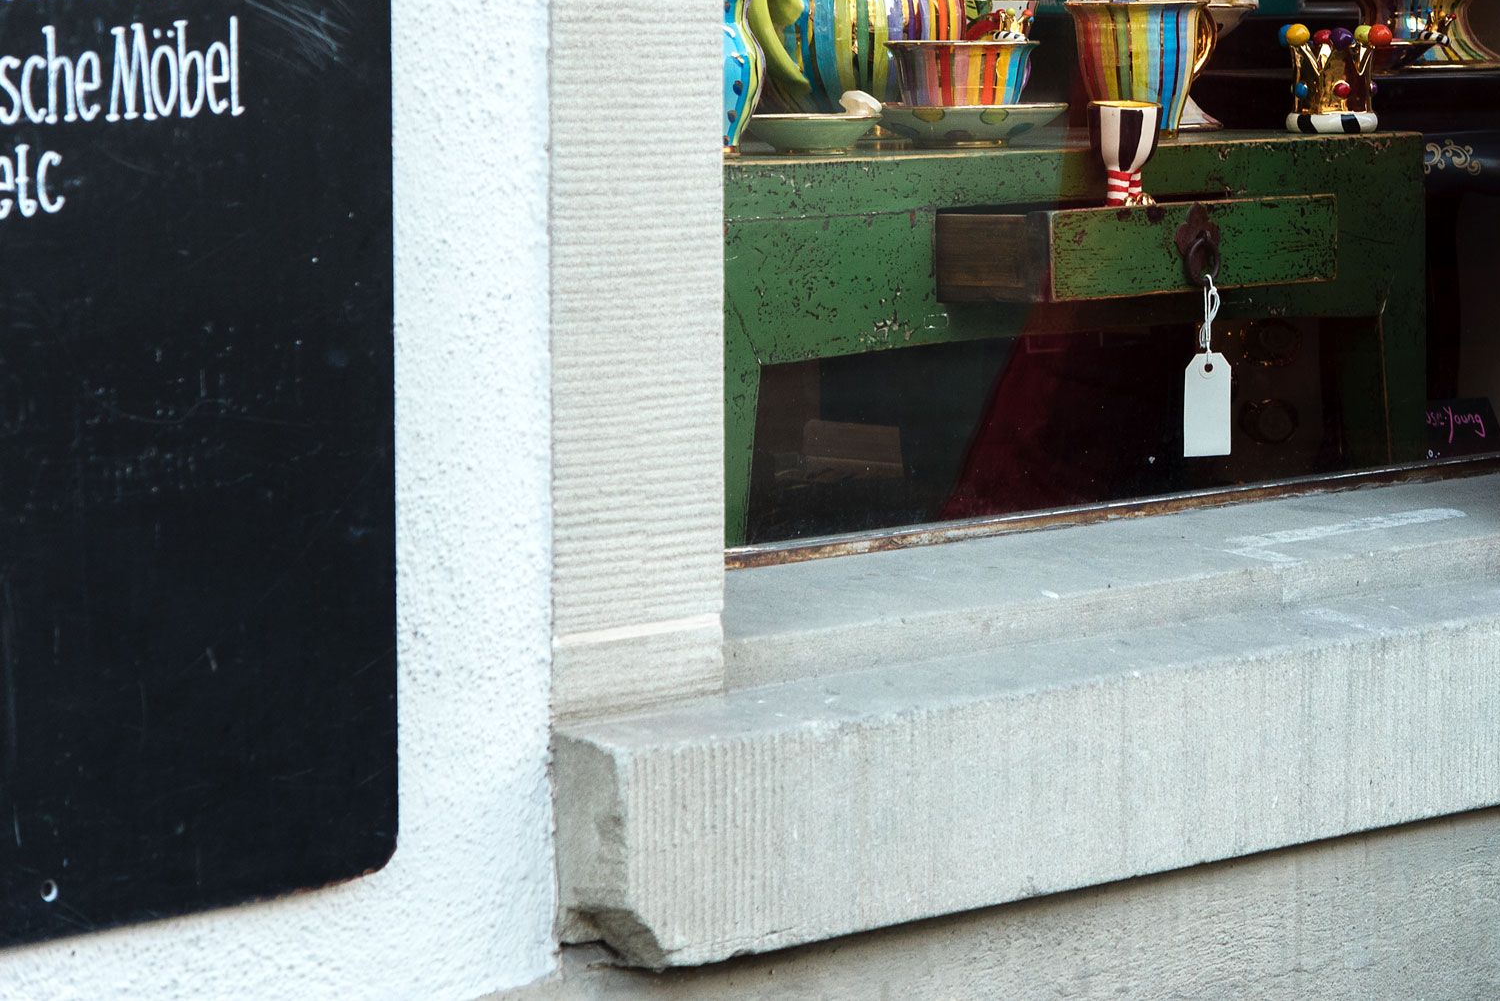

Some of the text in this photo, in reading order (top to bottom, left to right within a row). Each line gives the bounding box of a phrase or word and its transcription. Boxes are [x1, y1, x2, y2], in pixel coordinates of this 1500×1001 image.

[0, 15, 245, 125] sche Möbel
[0, 144, 66, 220] etc
